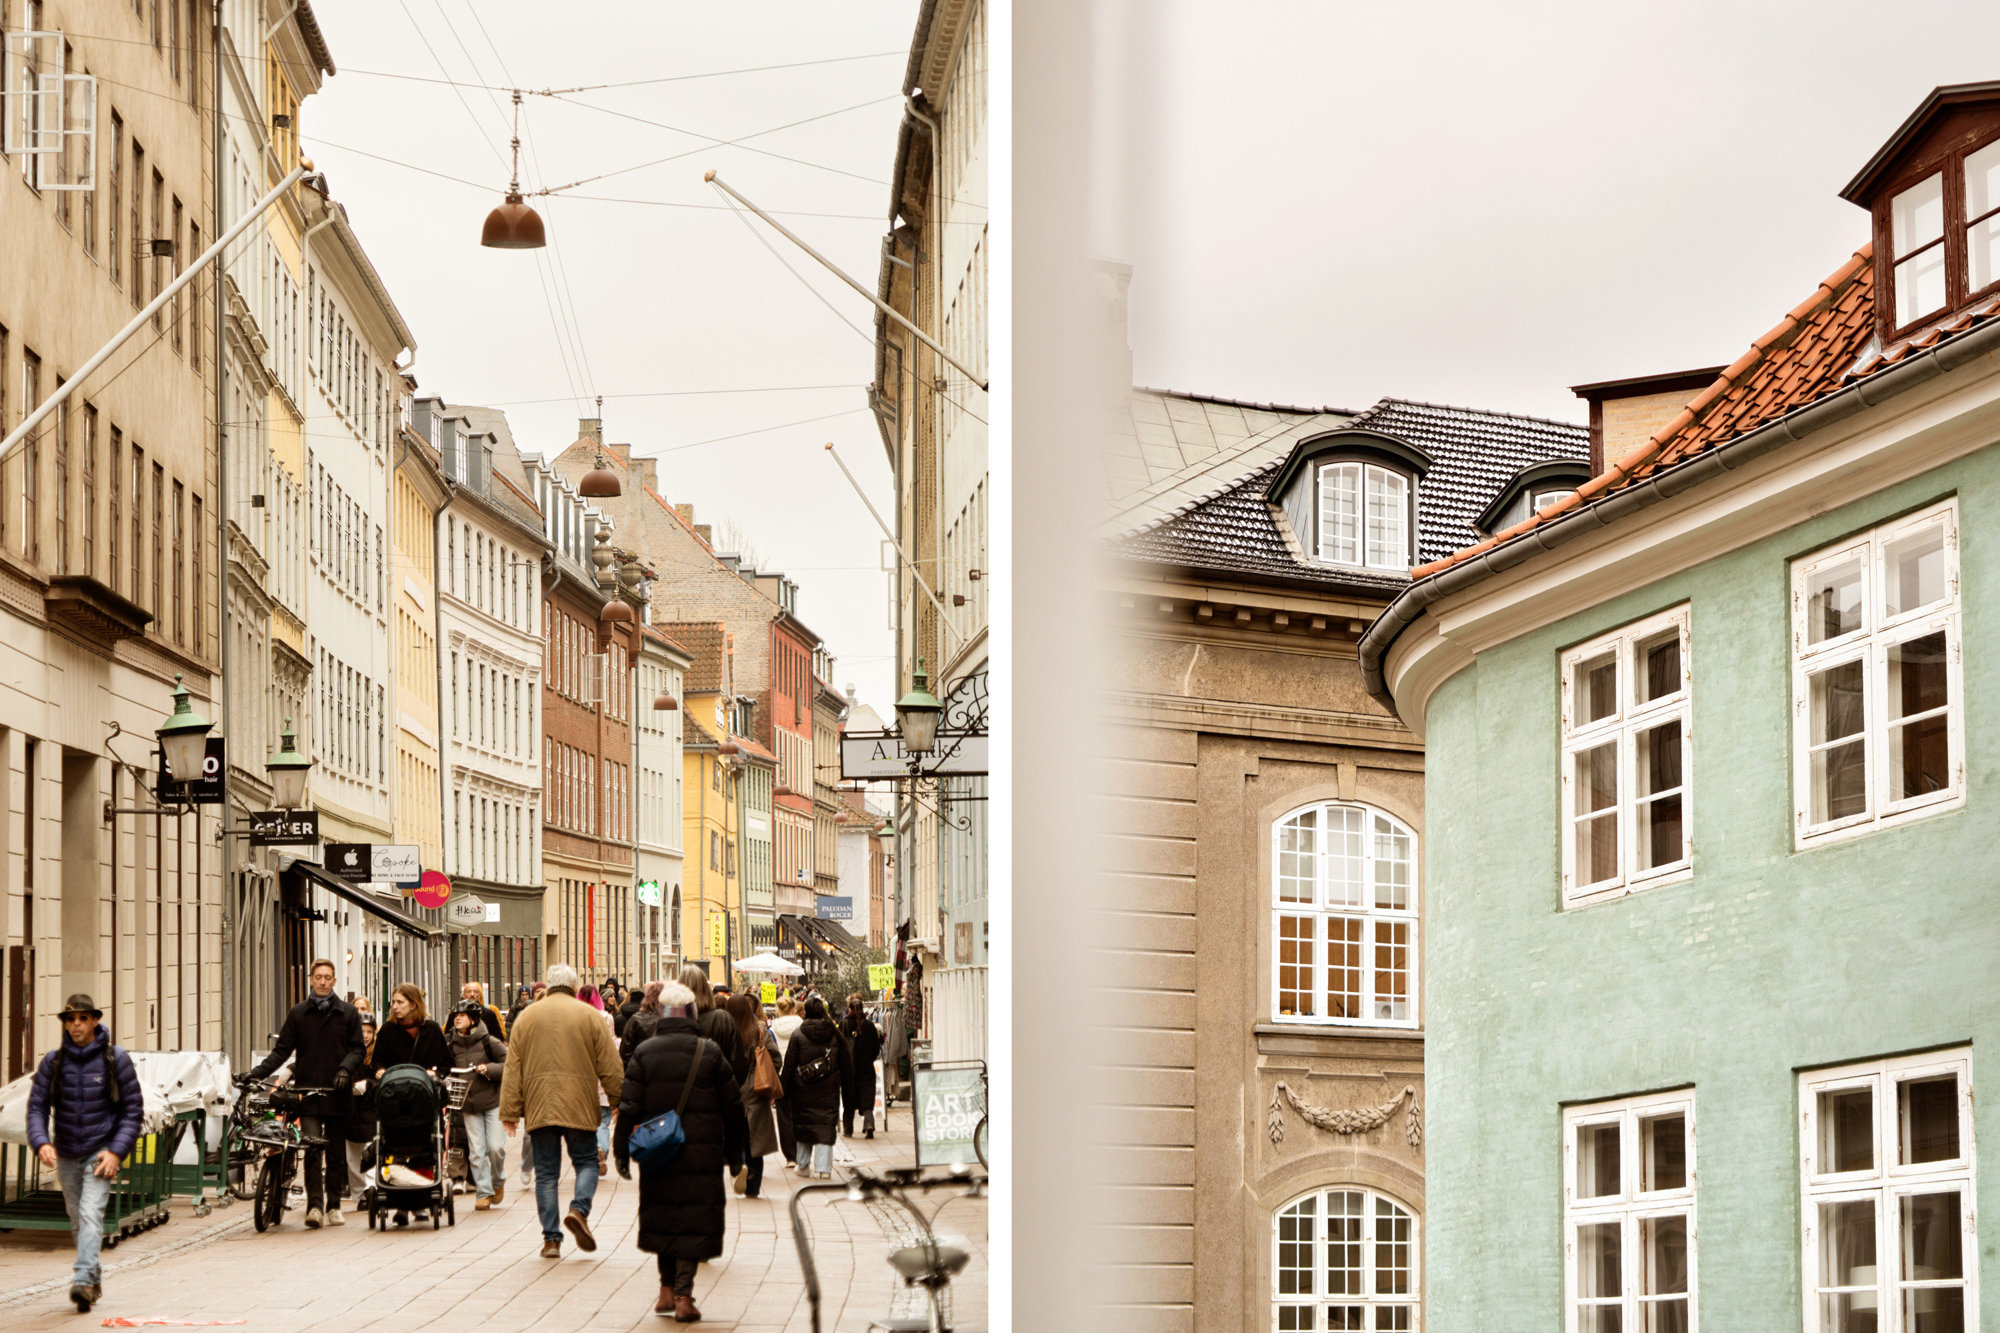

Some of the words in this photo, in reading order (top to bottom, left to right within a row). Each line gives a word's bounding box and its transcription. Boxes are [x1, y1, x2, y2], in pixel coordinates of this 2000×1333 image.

[872, 741, 892, 760] A.
[897, 739, 961, 760] Bke
[925, 1092, 975, 1113] ART
[925, 1112, 979, 1128] BOOK
[926, 1126, 975, 1141] STOR
